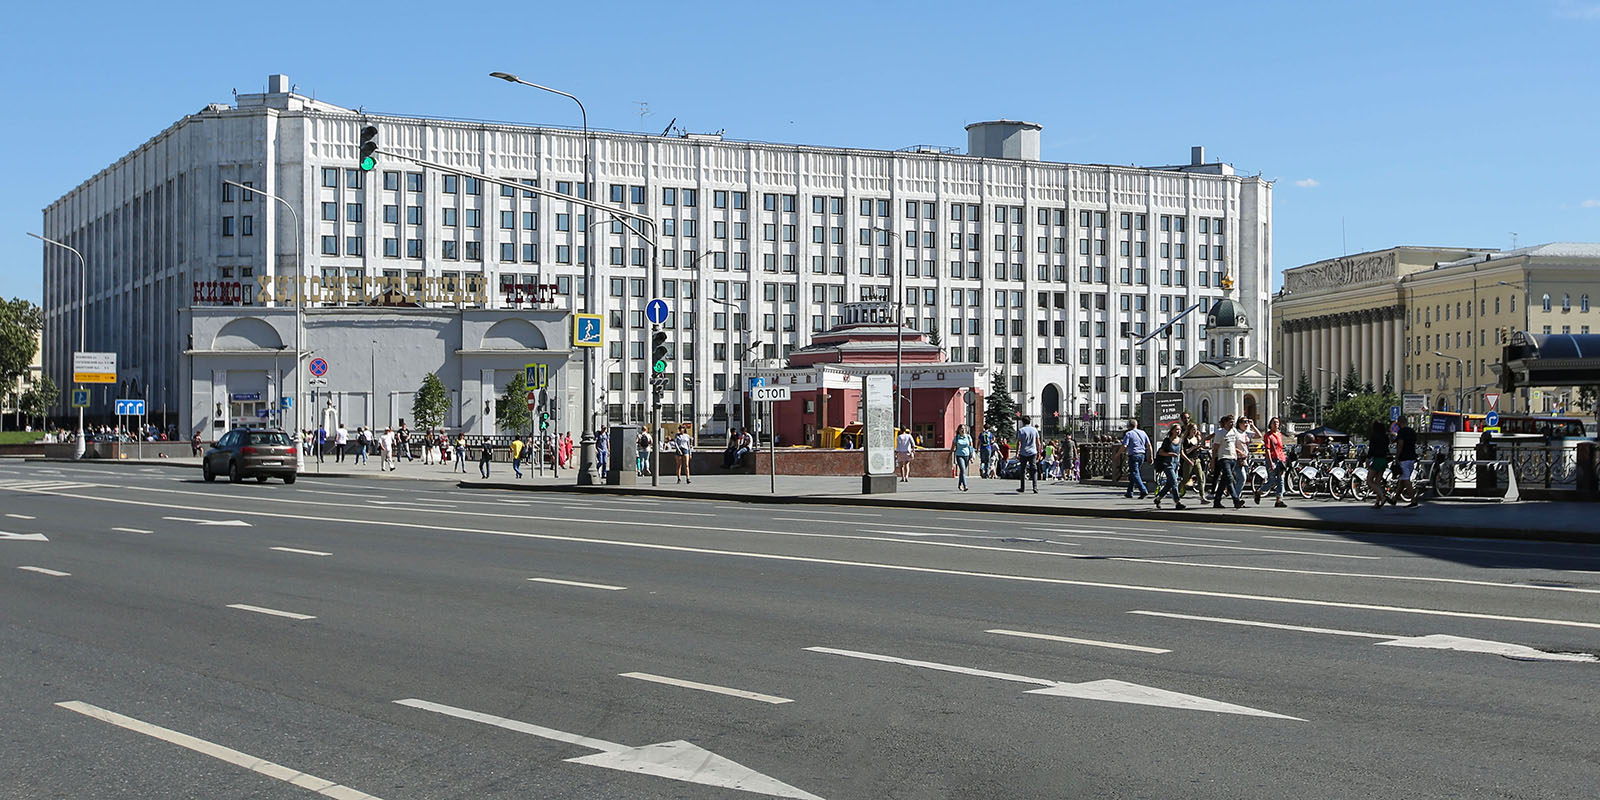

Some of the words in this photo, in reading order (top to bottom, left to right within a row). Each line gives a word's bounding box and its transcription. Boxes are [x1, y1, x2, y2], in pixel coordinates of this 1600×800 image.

[193, 282, 241, 302] КИНО
[257, 274, 487, 305] ХУДОЖЕСТВЕННЫЙ
[504, 284, 558, 304] ТЕАТР
[757, 388, 786, 399] СТОП
